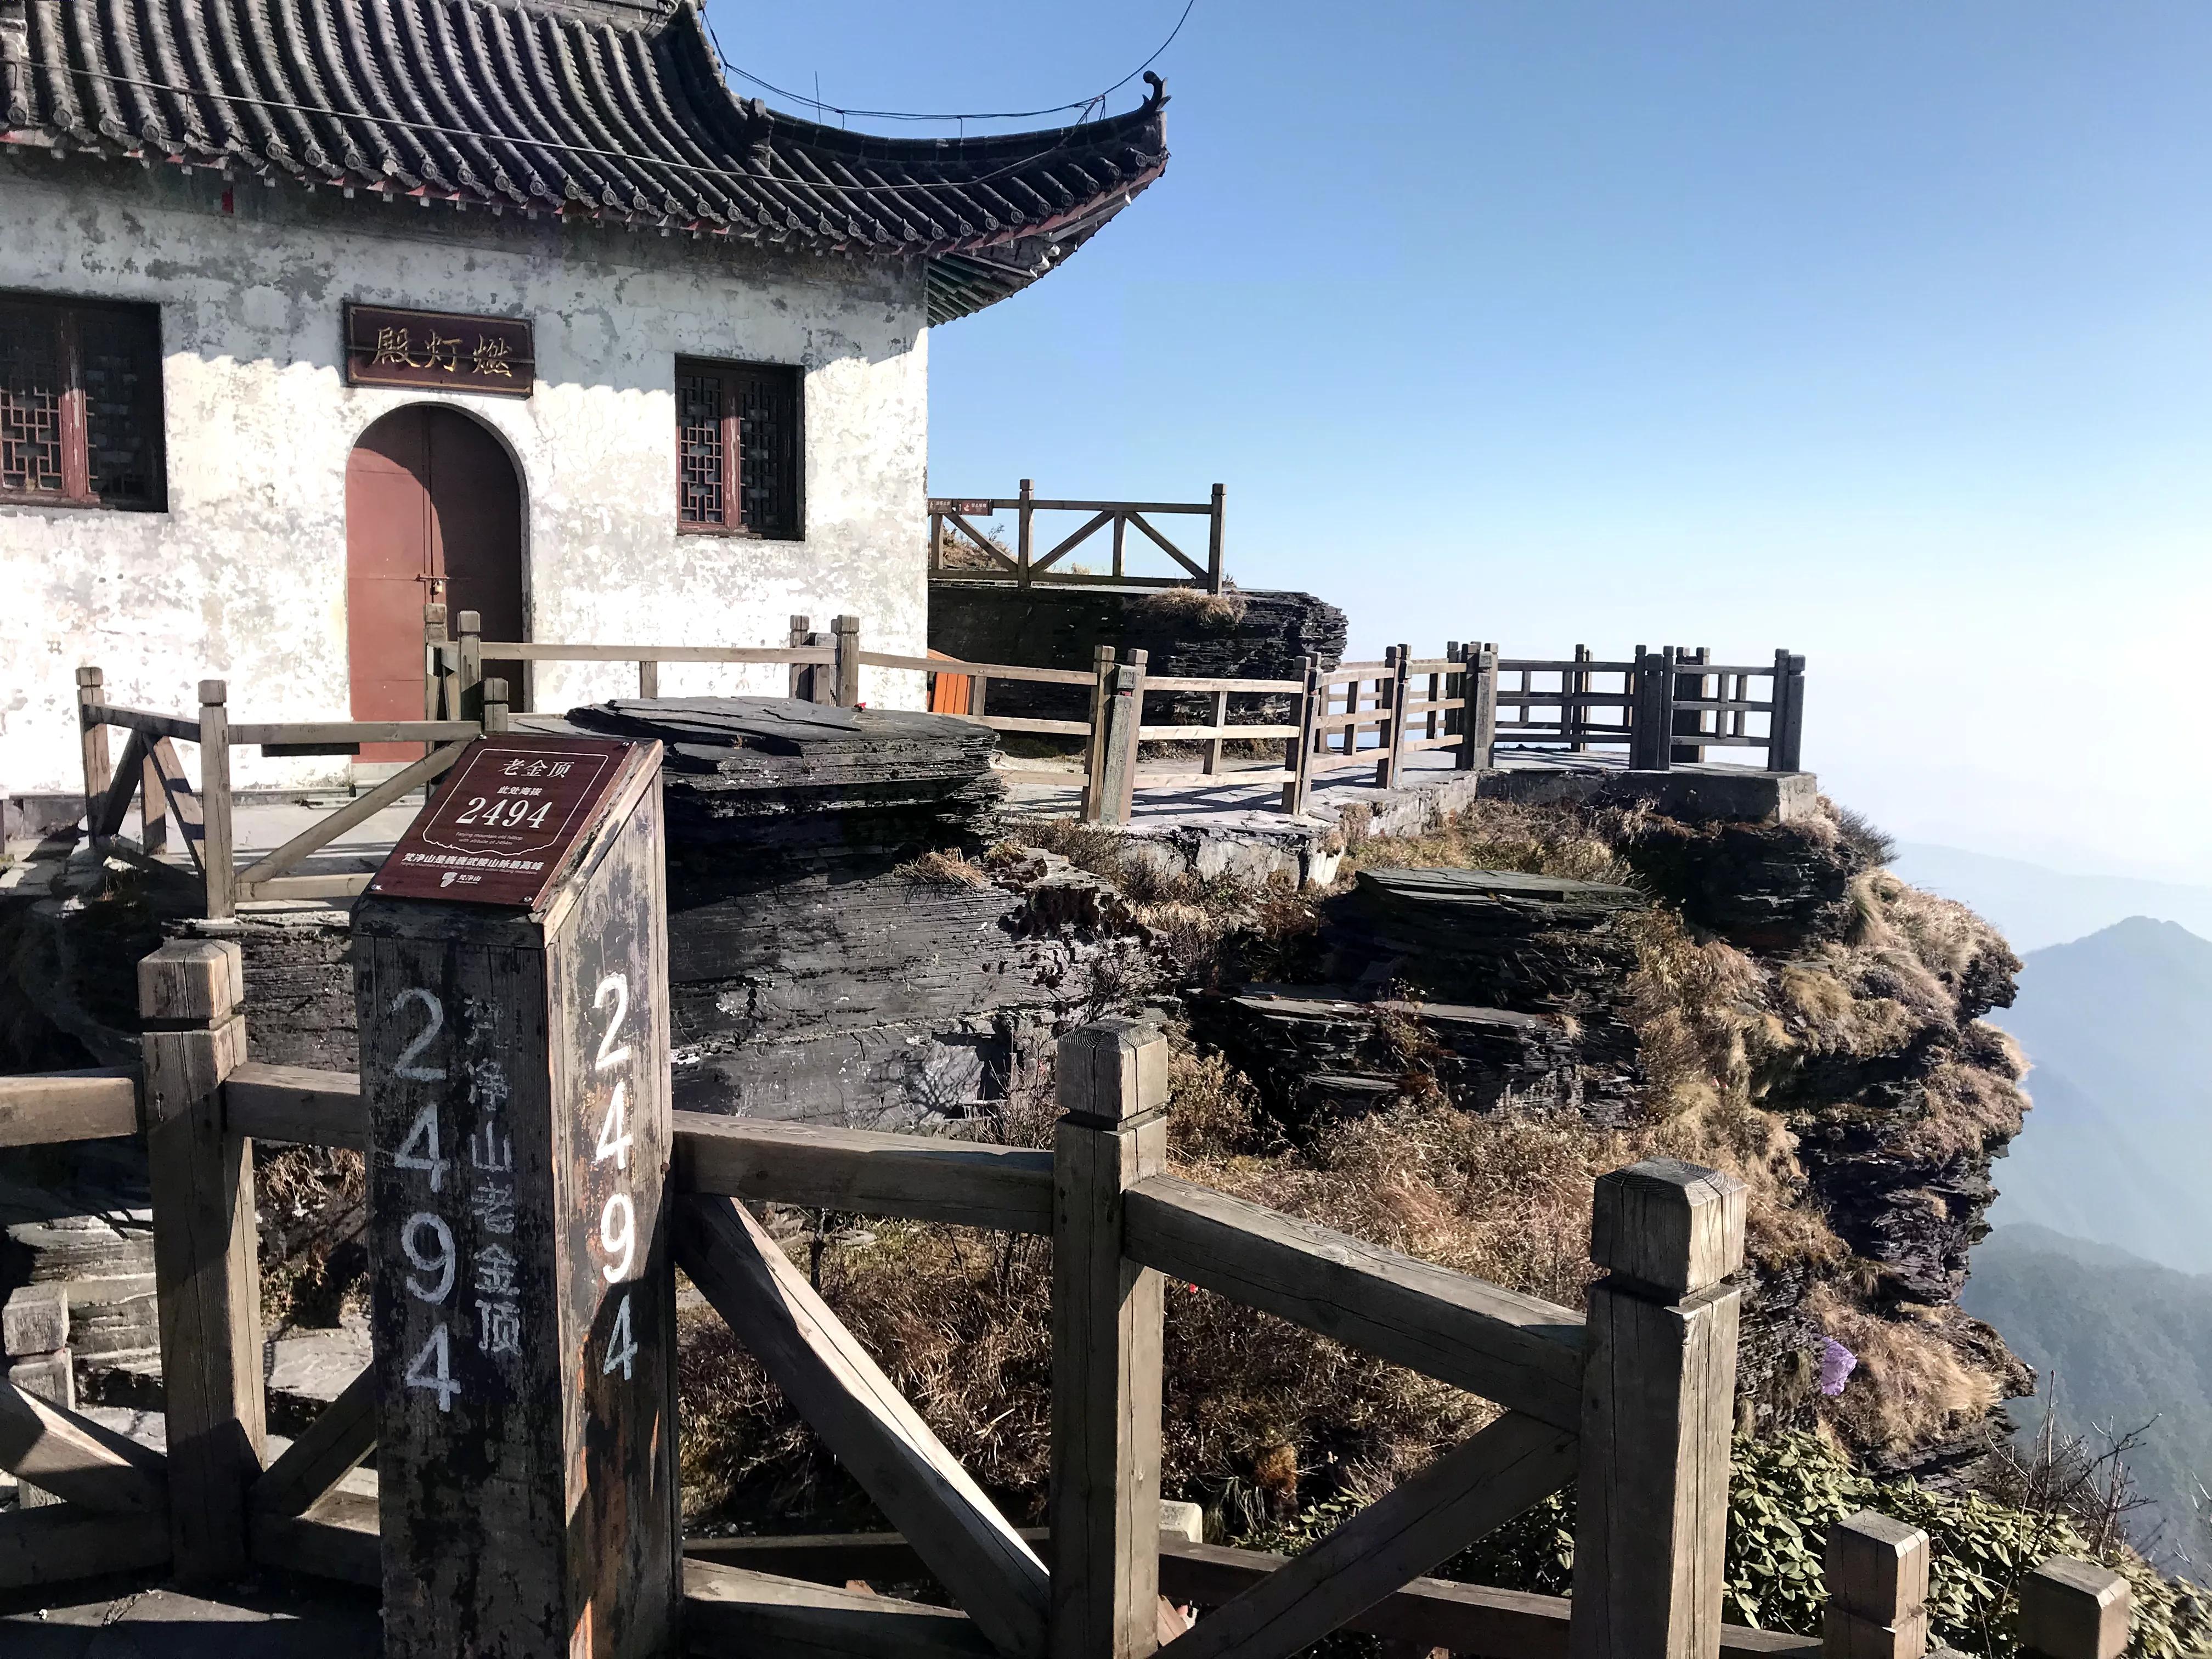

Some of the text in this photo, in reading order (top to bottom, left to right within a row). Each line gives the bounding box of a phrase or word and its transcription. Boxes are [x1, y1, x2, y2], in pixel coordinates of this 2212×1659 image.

[498, 758, 575, 778] 老金顶
[497, 786, 543, 796] 此处海拔
[455, 797, 553, 828] 2494
[594, 970, 639, 1381] 2494
[392, 988, 461, 1413] 2494
